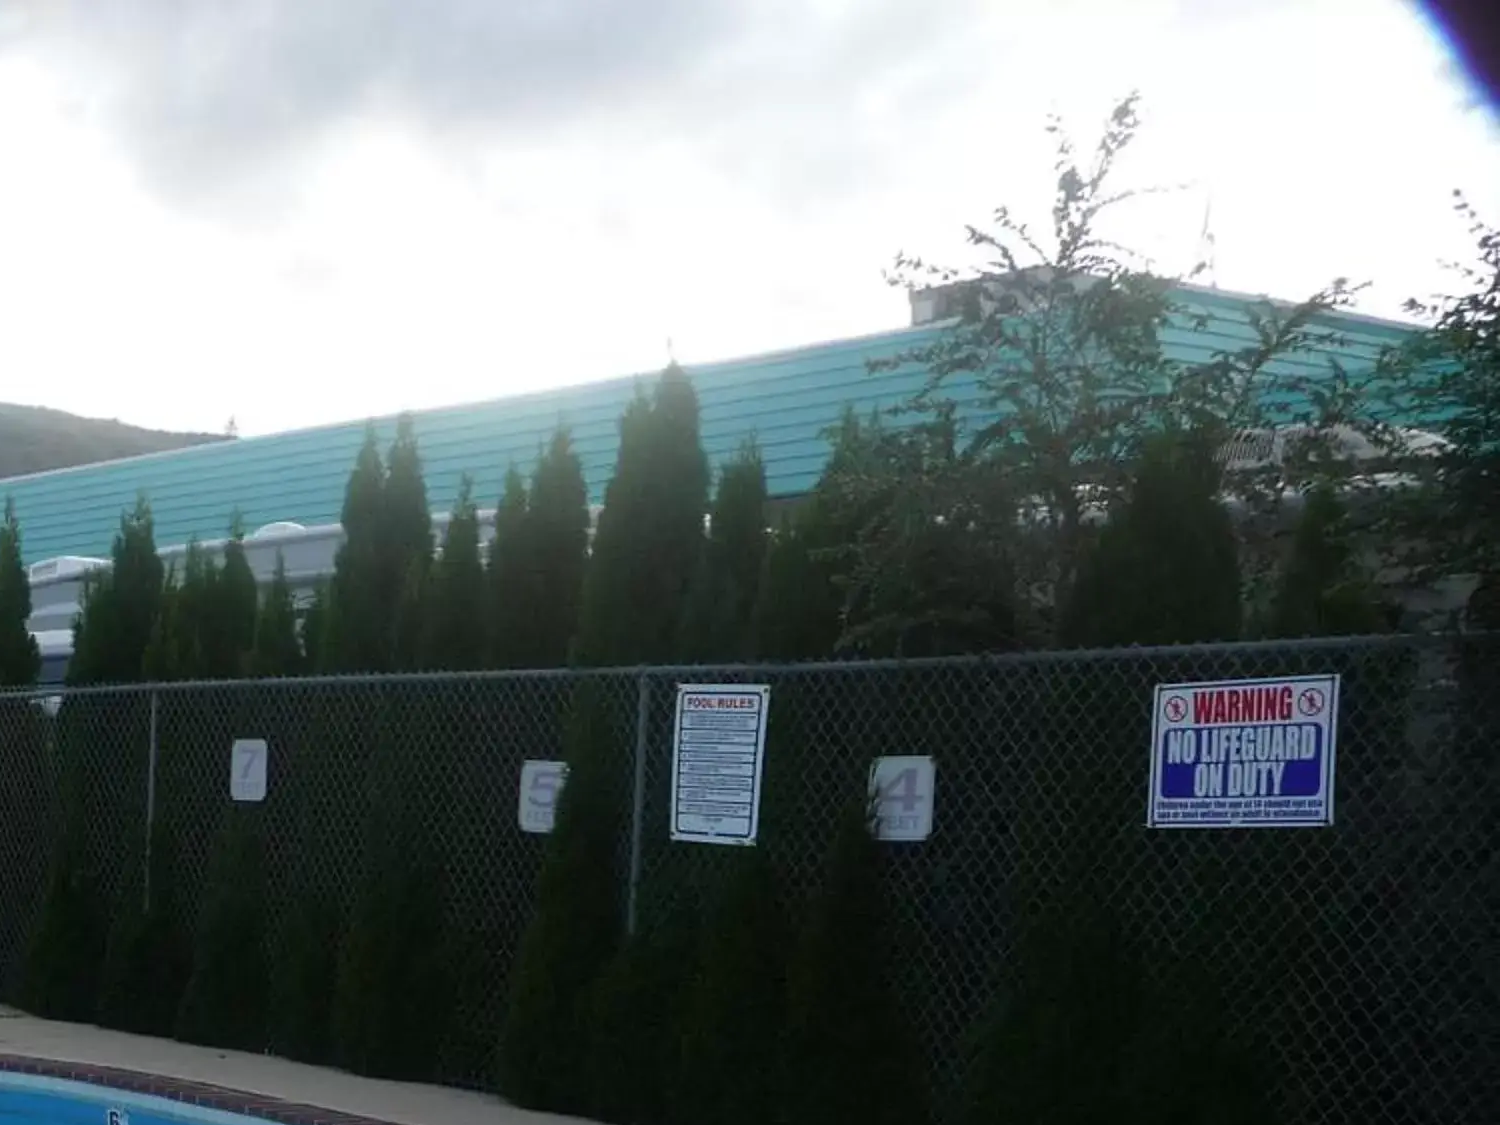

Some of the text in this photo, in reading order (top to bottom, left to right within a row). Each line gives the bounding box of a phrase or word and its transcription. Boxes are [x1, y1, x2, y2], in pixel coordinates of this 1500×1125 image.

[687, 697, 755, 709] POOL RULES
[1193, 685, 1293, 724] WARNING
[240, 747, 260, 779] 7
[1167, 724, 1317, 764] NO LIFEGUARD
[528, 770, 561, 809] 5
[878, 767, 924, 813] 4
[1193, 761, 1286, 797] ON DUTY
